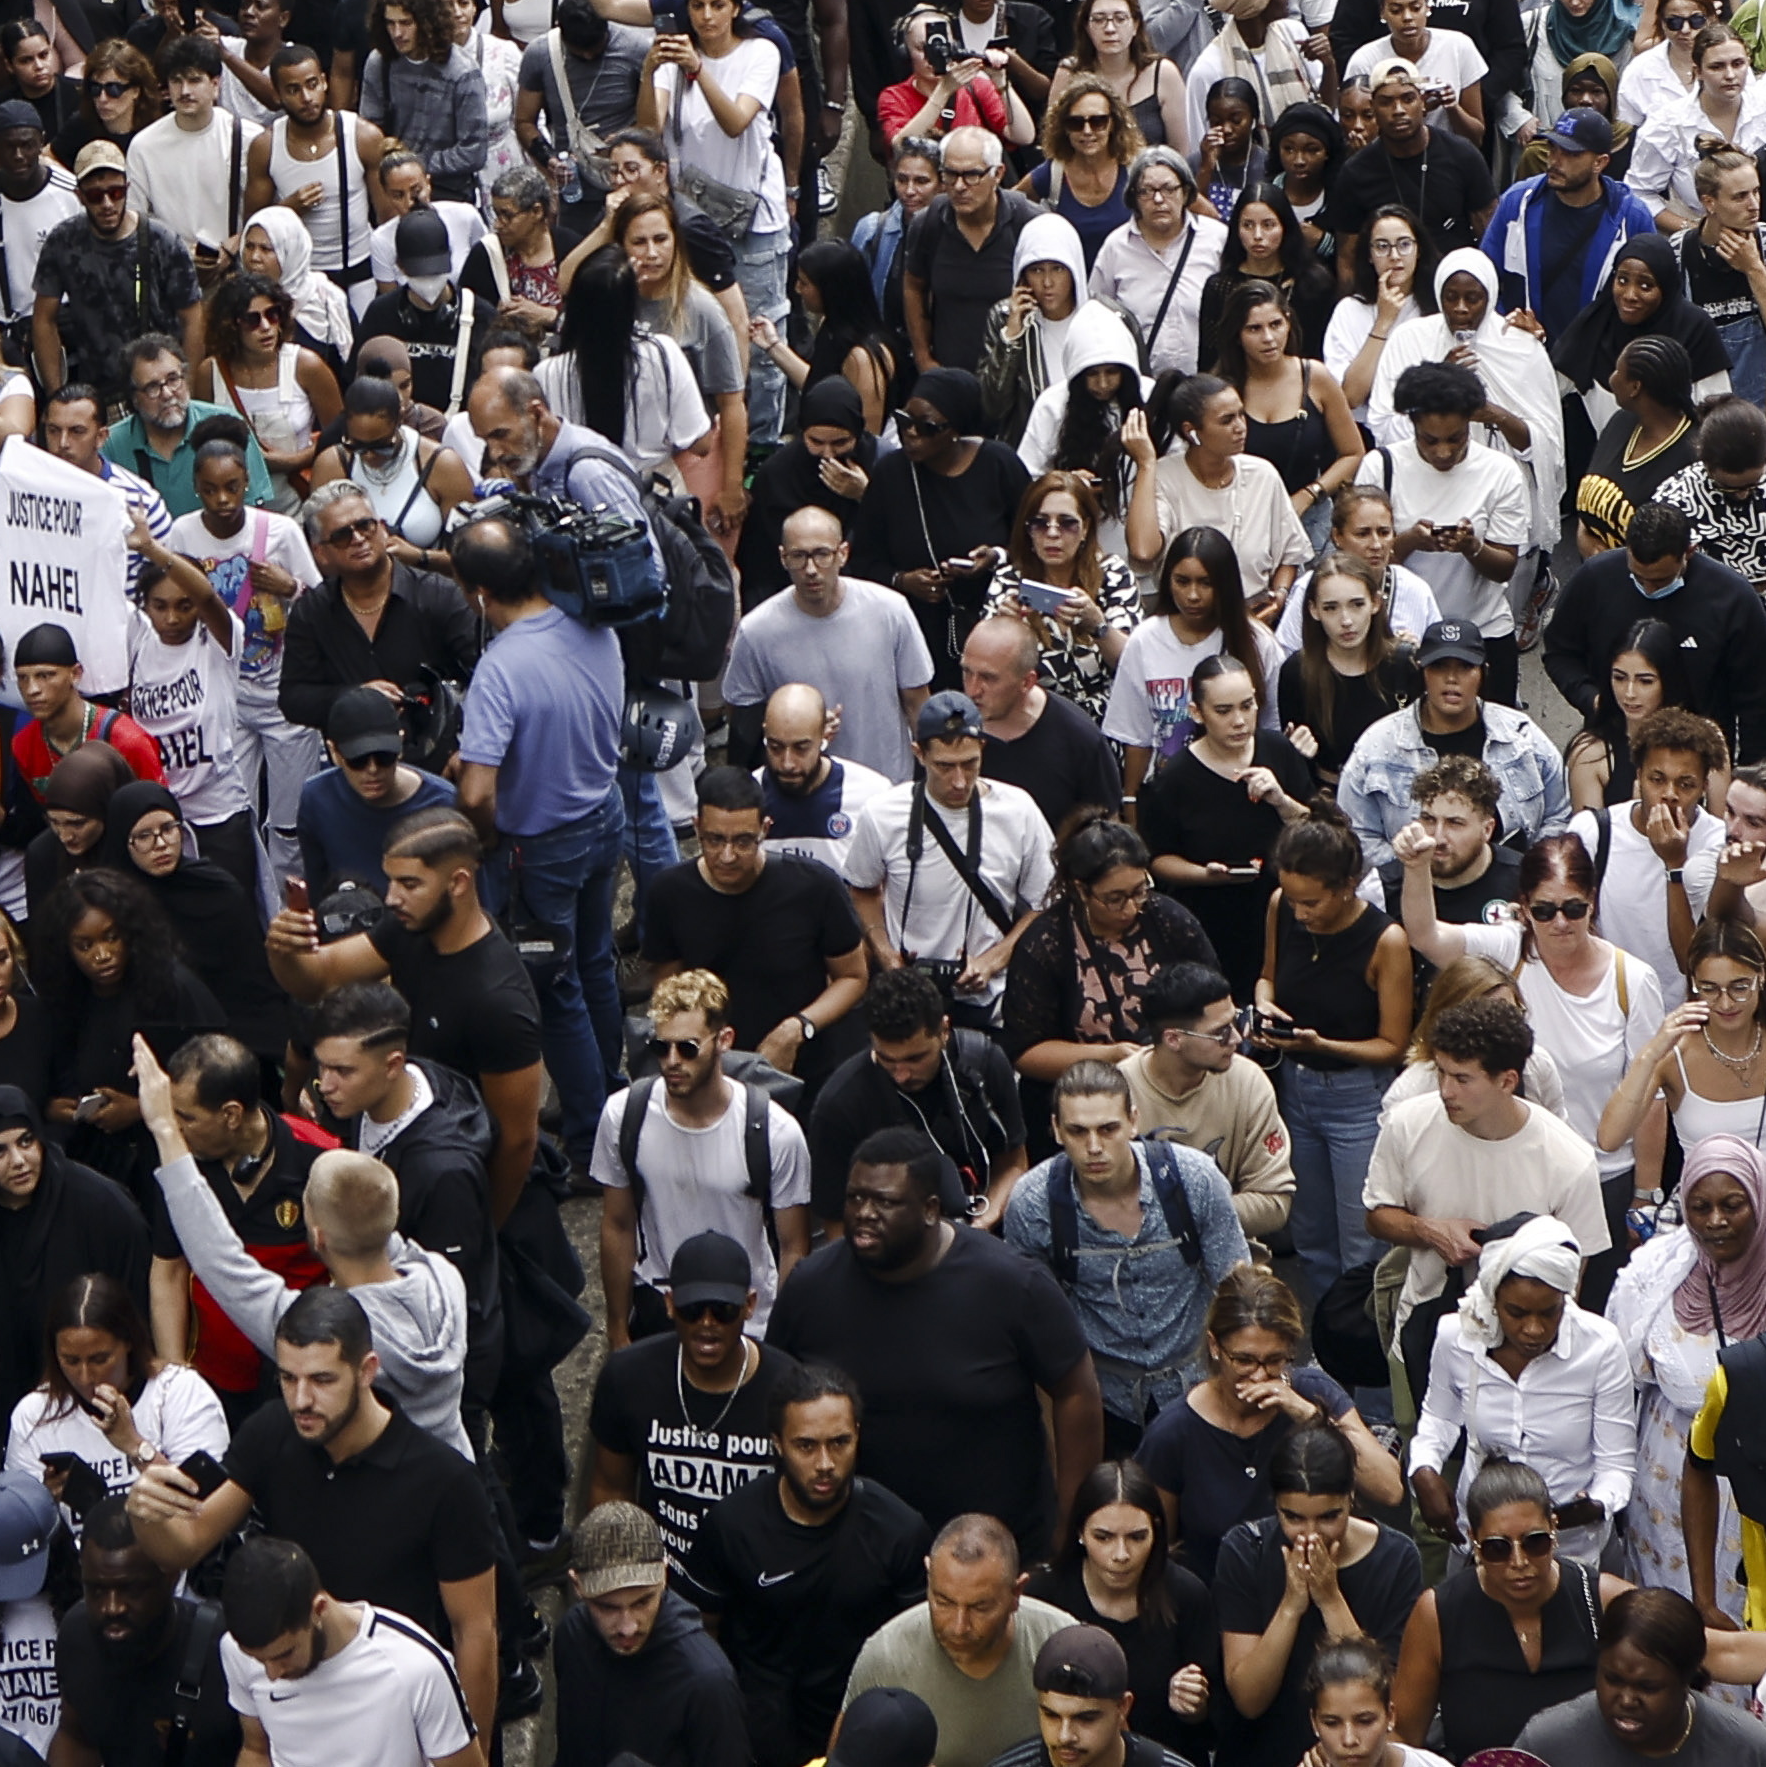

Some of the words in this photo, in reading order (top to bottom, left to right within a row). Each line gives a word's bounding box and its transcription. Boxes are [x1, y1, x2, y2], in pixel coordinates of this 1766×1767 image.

[7, 493, 52, 532] JUSTICE
[53, 498, 82, 538] POUR
[11, 561, 82, 615] NAHEL
[170, 668, 205, 711] POUR
[648, 1419, 719, 1452] Justice
[659, 1500, 698, 1532] sans
